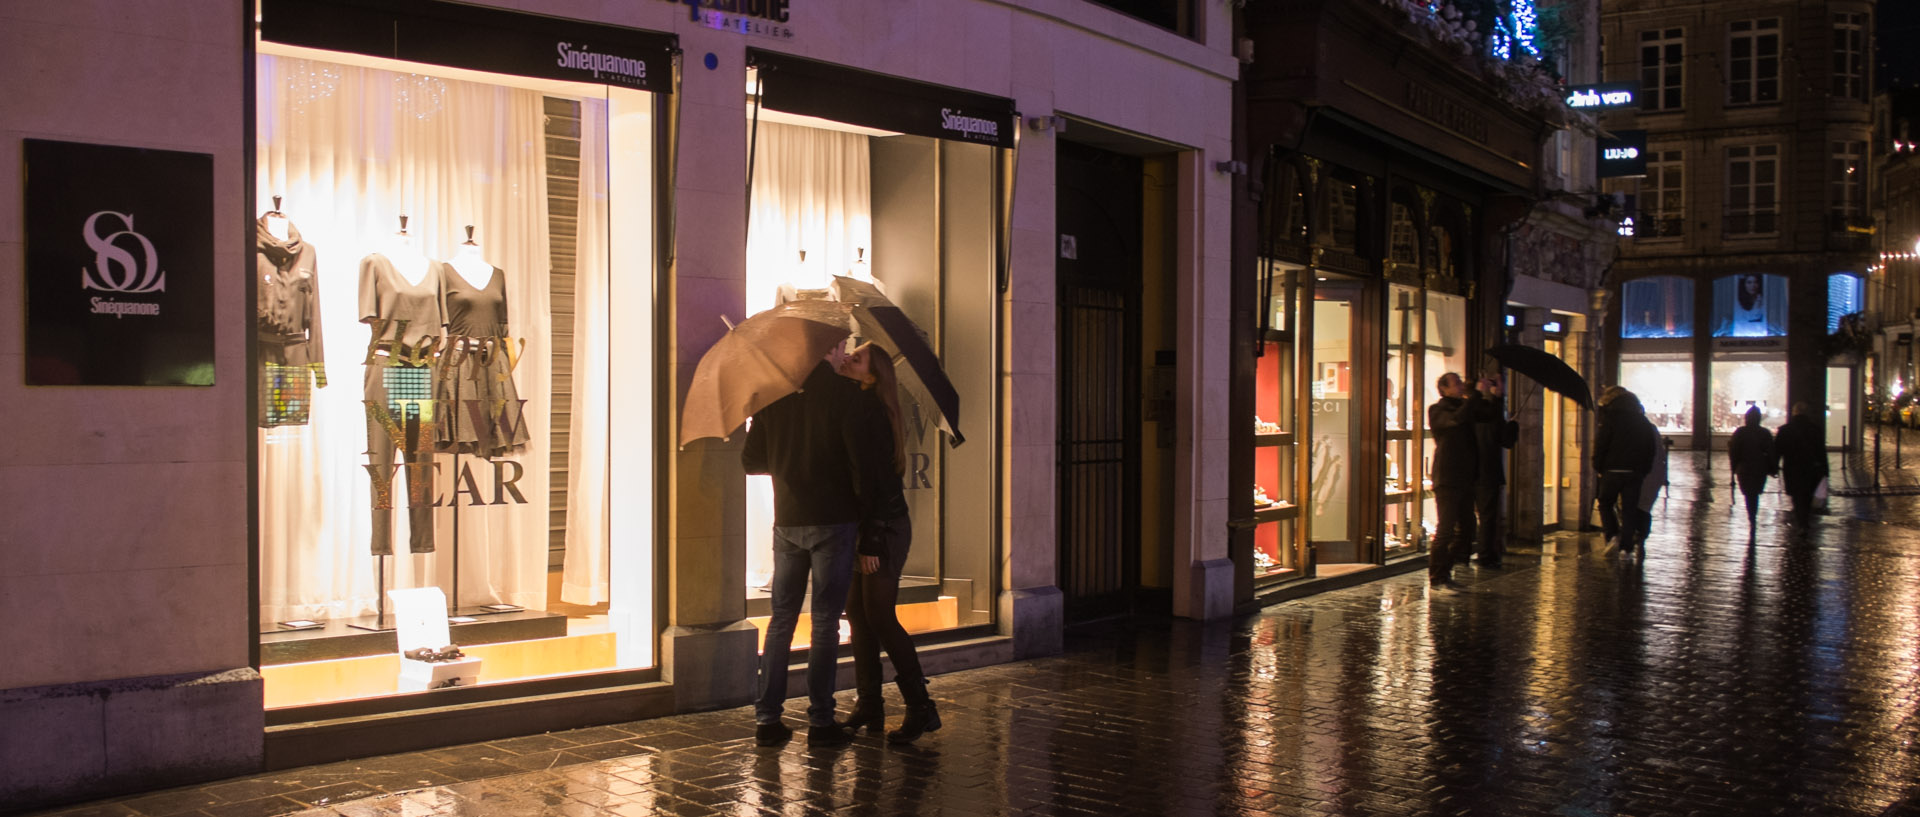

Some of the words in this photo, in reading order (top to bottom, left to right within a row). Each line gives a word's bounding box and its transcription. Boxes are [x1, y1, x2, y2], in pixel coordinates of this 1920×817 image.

[557, 42, 647, 78] Sinéquanone
[1566, 89, 1601, 107] dinh
[1601, 92, 1632, 104] van
[941, 108, 998, 137] Sinéquanone
[91, 296, 160, 319] Sinéquanone
[361, 319, 526, 382] Happy
[361, 399, 529, 457] NEW
[361, 461, 529, 510] YEAR
